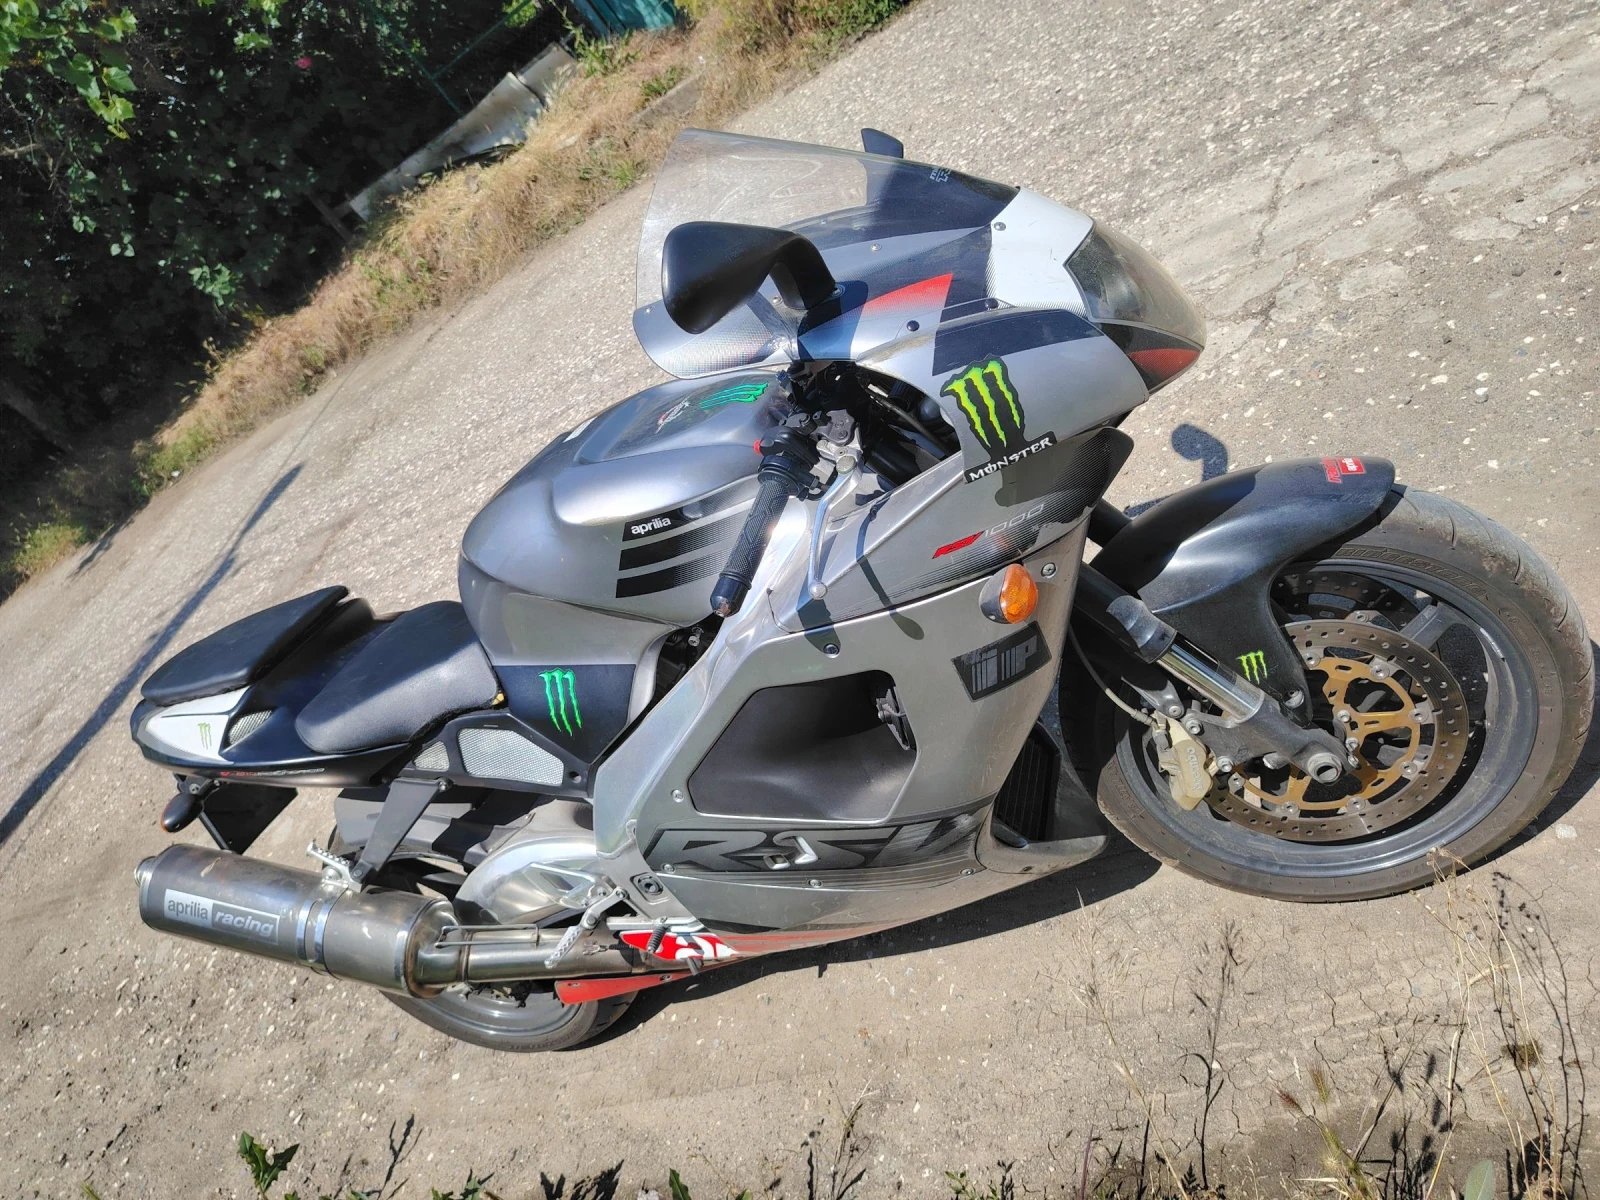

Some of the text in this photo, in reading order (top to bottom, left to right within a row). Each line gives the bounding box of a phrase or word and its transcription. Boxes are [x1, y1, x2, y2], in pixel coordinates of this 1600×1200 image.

[968, 436, 1054, 482] MONSTER
[630, 516, 672, 535] aprilia
[982, 503, 1045, 537] 1000
[167, 899, 275, 937] aprilia racing
